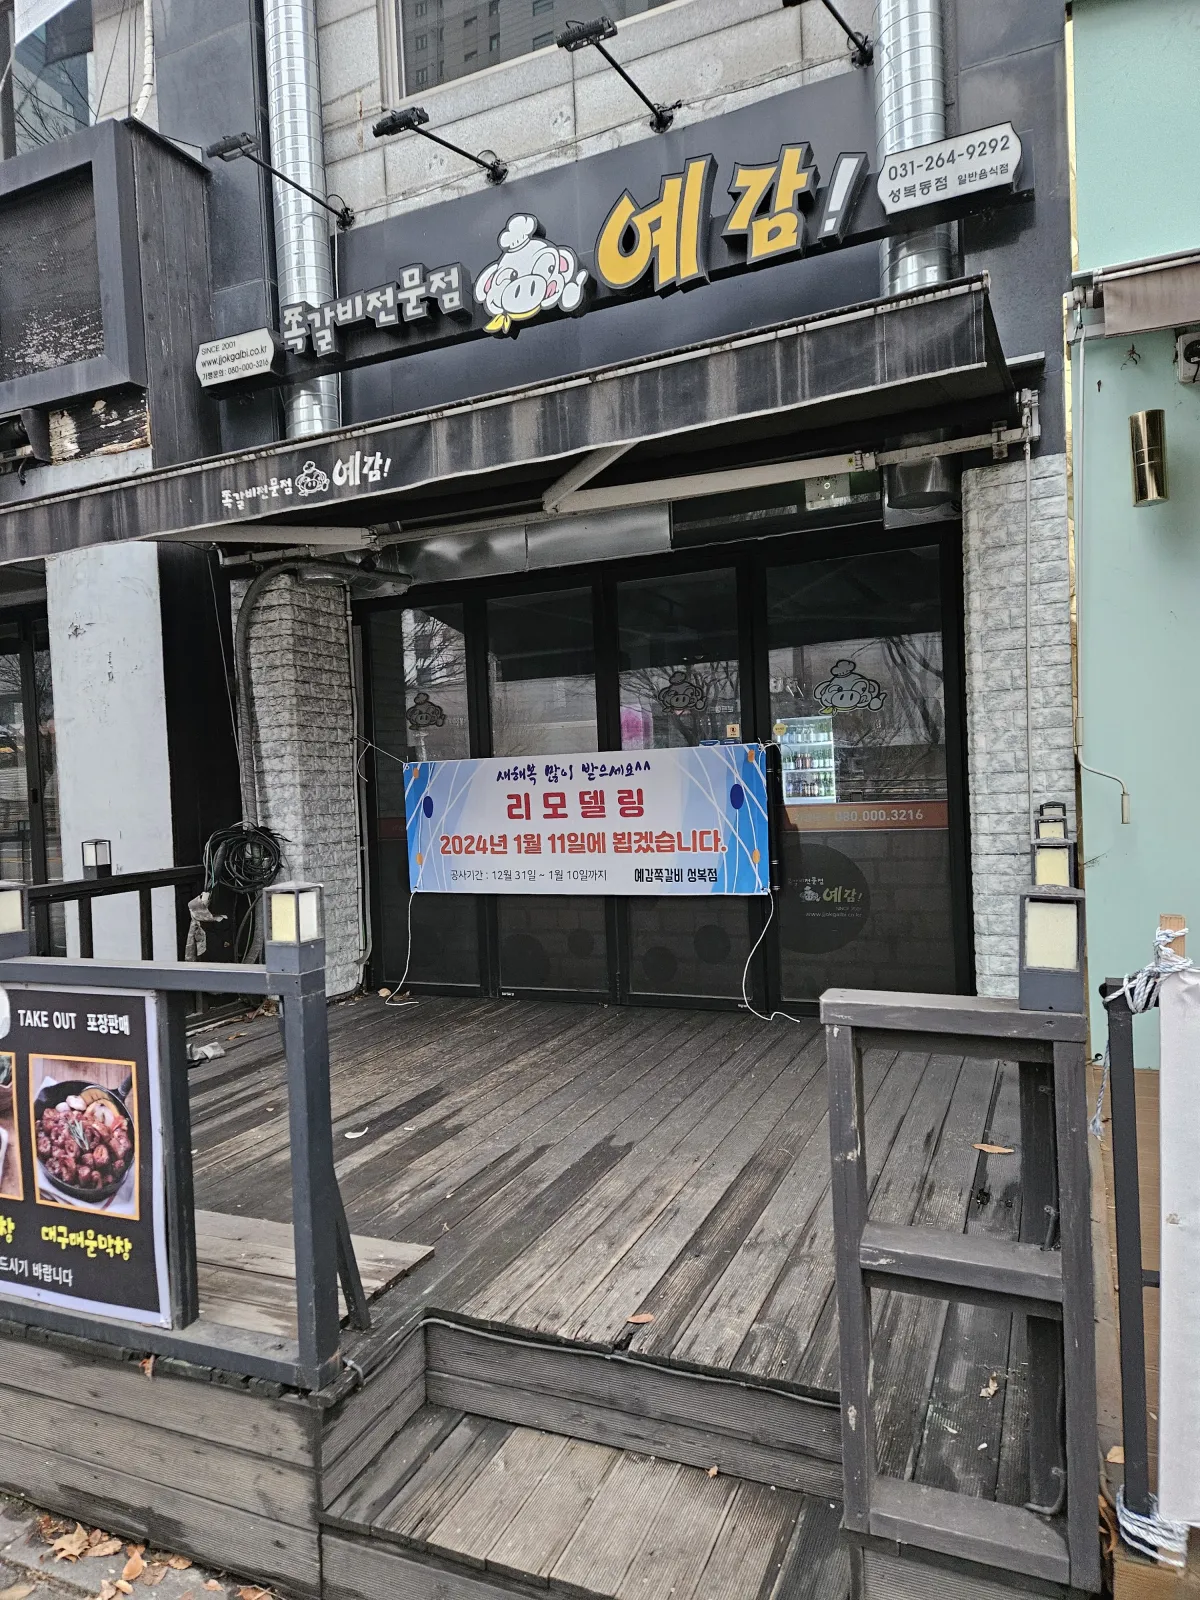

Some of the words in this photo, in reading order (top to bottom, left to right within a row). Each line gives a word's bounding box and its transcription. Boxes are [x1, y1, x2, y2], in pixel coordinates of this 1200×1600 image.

[887, 134, 1010, 181] 031-264-9292
[888, 175, 948, 204] 성복동점
[957, 162, 1009, 186] 일반음식점
[283, 266, 461, 352] 쪽갈비전문점
[597, 147, 860, 286] 예감!
[201, 344, 220, 356] SINCE
[222, 340, 236, 351] 2001
[201, 345, 267, 368] www.jjokgalbi.co.kr
[228, 358, 270, 375] 080-000-3216
[221, 477, 293, 511] 쪽갈비전문점
[332, 450, 392, 487] 예감!
[544, 763, 574, 783] 많이
[834, 808, 924, 822] 080.000.3216
[439, 833, 508, 855] 2024년
[513, 833, 542, 855] 1월
[547, 832, 607, 854] 11일에
[612, 829, 727, 854] 뵙겠습니다.
[450, 869, 483, 881] 공사기간
[491, 869, 513, 882] 12월
[514, 869, 536, 881] 31일
[548, 869, 563, 882] 1월
[566, 868, 607, 882] 10일까지
[634, 868, 684, 883] 예감쪽갈비
[687, 867, 718, 883] 성복점
[822, 885, 863, 903] 예감!
[17, 1009, 50, 1028] TAKE
[52, 1011, 77, 1030] OUT
[86, 1013, 131, 1036] 포장판매
[41, 1225, 133, 1261] 대구매운막창
[32, 1262, 74, 1287] 바랍니다
